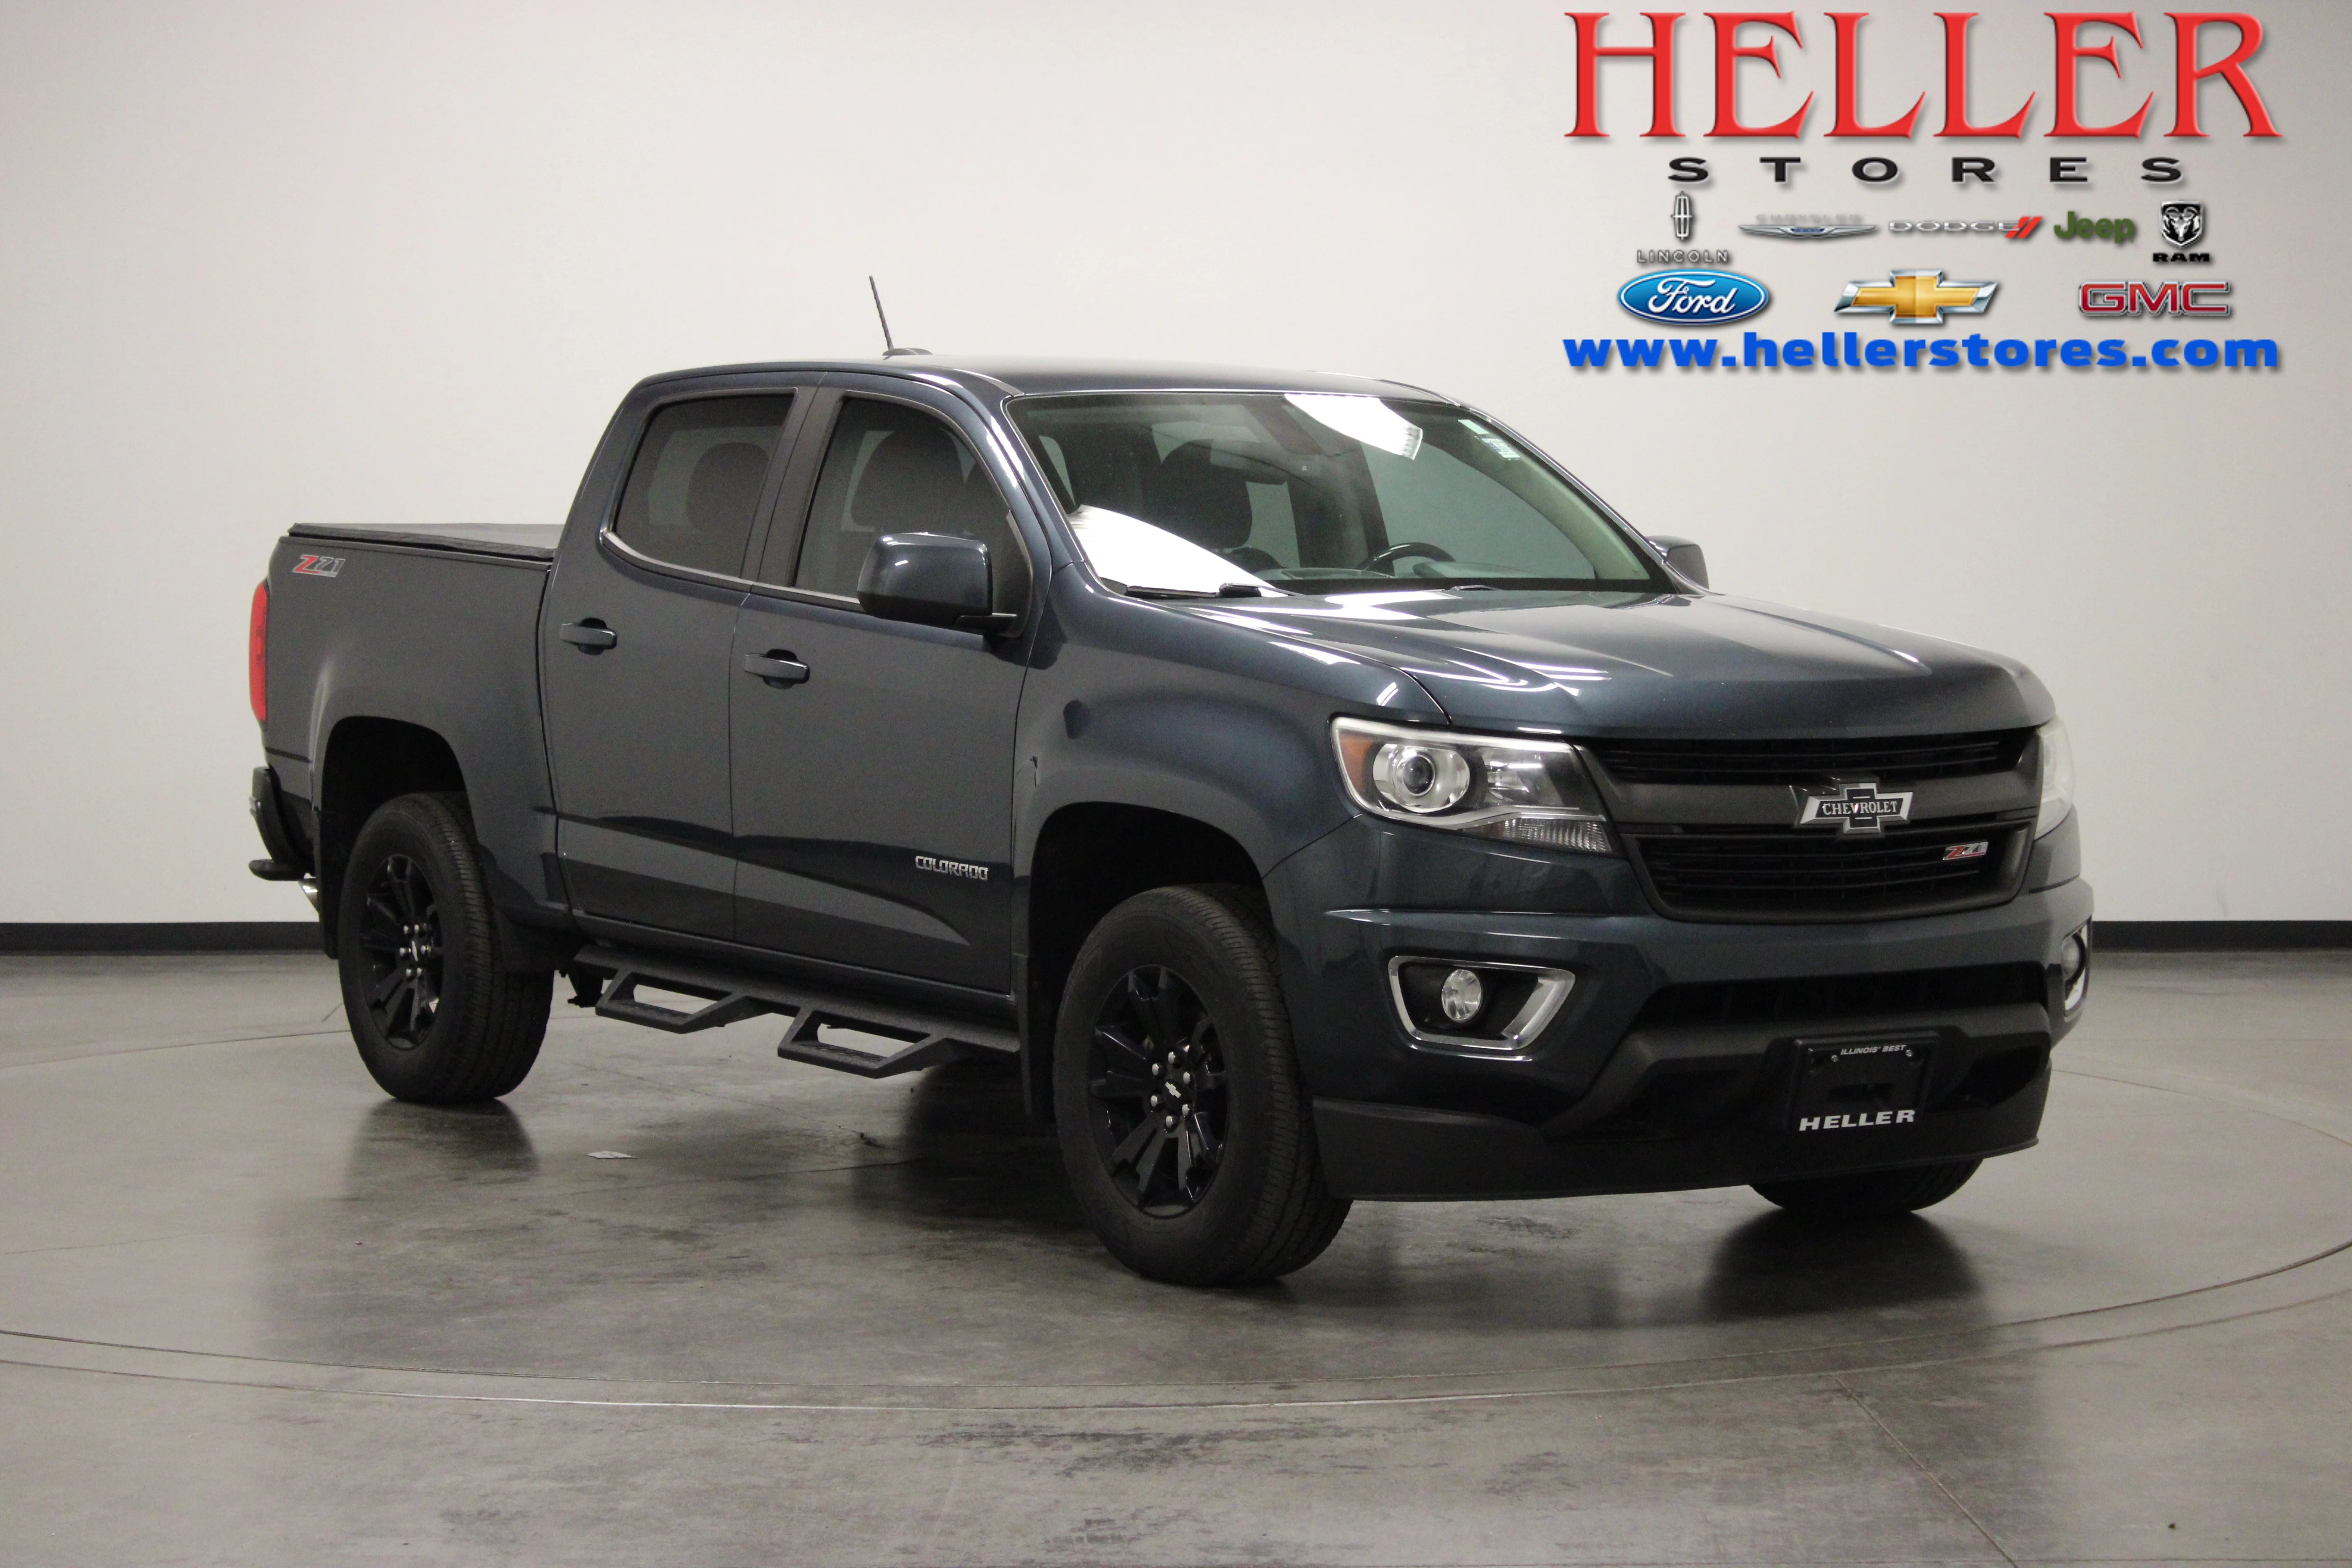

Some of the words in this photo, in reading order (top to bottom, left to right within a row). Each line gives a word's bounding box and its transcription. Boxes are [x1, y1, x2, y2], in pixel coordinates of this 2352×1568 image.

[292, 554, 346, 577] Z71
[1822, 801, 1898, 815] CHEVROLET
[1942, 842, 1988, 860] Z71
[915, 856, 989, 880] COLORADO
[1799, 1109, 1915, 1131] HELLER
